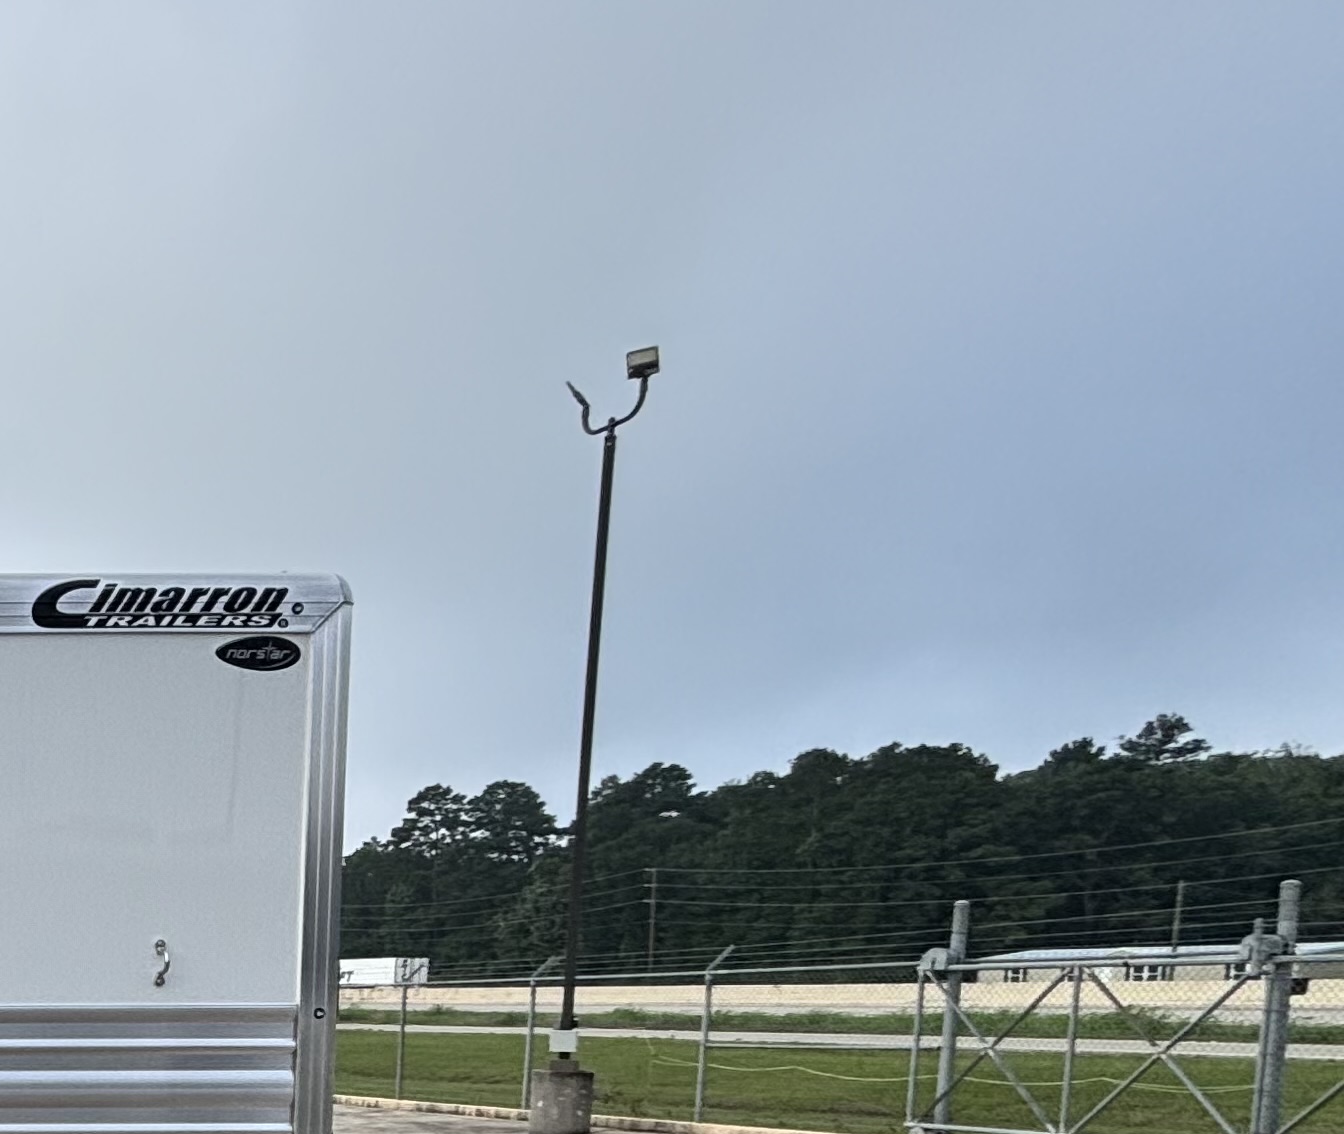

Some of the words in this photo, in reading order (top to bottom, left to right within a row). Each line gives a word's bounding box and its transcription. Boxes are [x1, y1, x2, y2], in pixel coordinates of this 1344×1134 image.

[31, 579, 289, 628] Cimarron
[84, 615, 273, 627] TRAILERS
[225, 641, 292, 661] norstar
